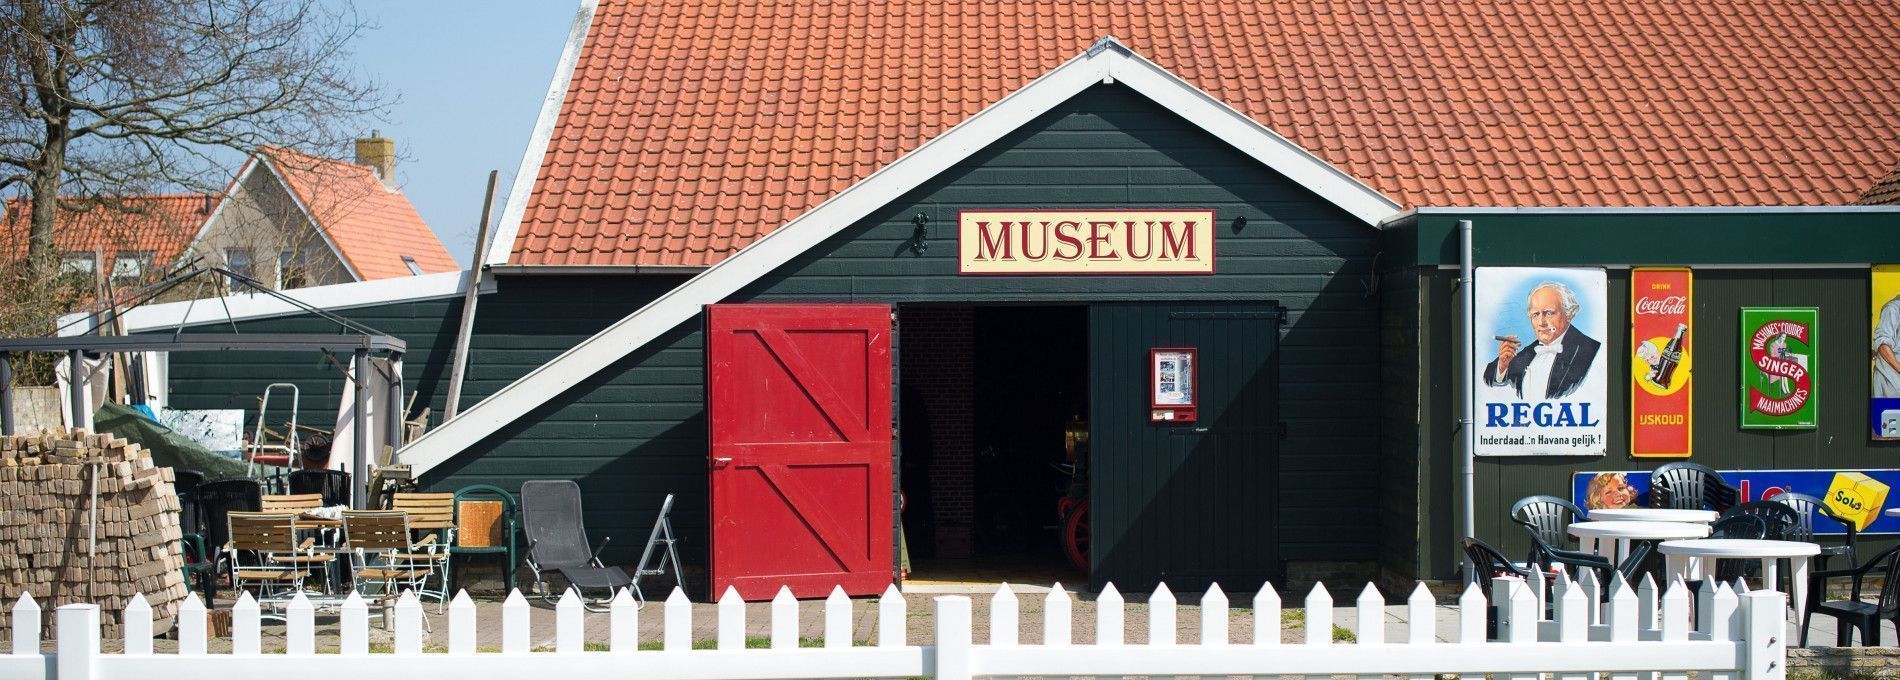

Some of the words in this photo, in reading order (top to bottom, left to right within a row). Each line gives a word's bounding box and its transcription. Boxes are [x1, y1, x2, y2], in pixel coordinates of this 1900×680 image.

[973, 221, 1201, 262] MUSEUM
[1635, 296, 1687, 315] Coca-Cola
[1752, 322, 1779, 350] MACHINES
[1780, 321, 1805, 339] COUDRE
[1758, 355, 1804, 383] SINGER
[1756, 387, 1808, 414] NAAIMACHINES
[1486, 402, 1600, 428] REGAL
[1538, 434, 1570, 445] Havana
